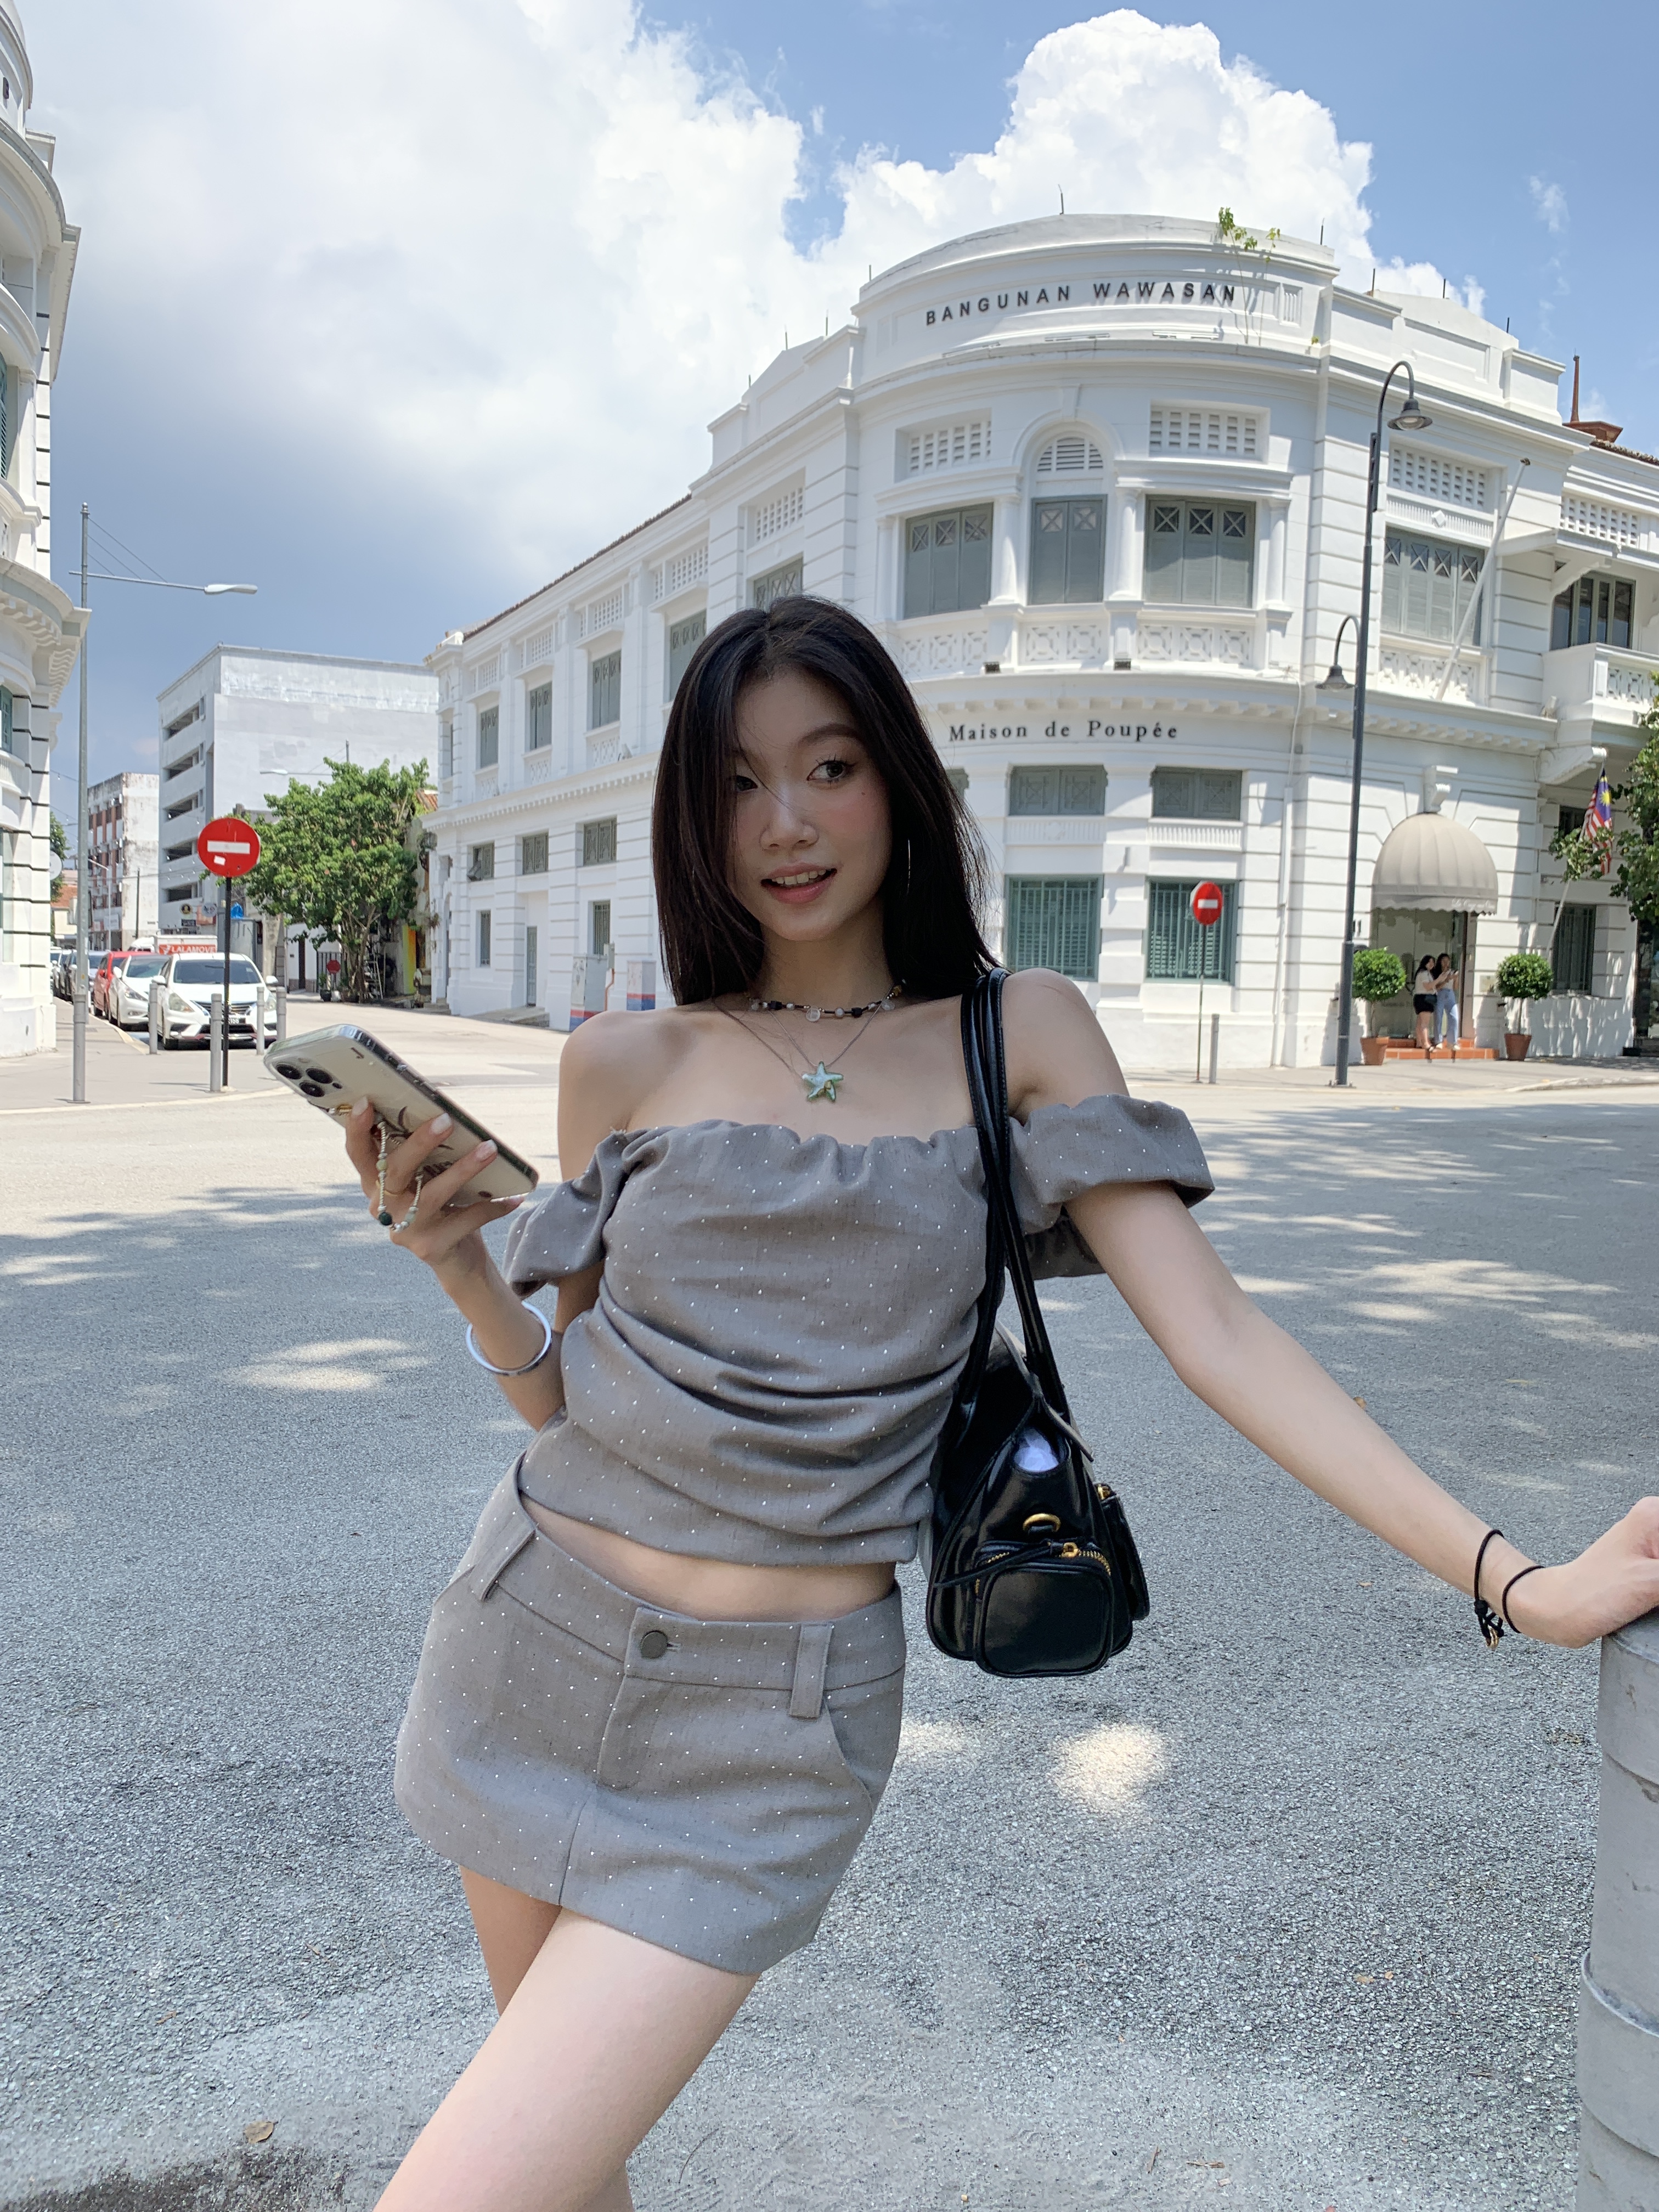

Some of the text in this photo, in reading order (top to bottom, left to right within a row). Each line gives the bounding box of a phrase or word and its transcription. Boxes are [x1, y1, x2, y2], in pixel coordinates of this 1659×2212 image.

[927, 281, 1234, 325] BANGUNAN WAWASAN
[950, 720, 1177, 742] Maison de Poupée
